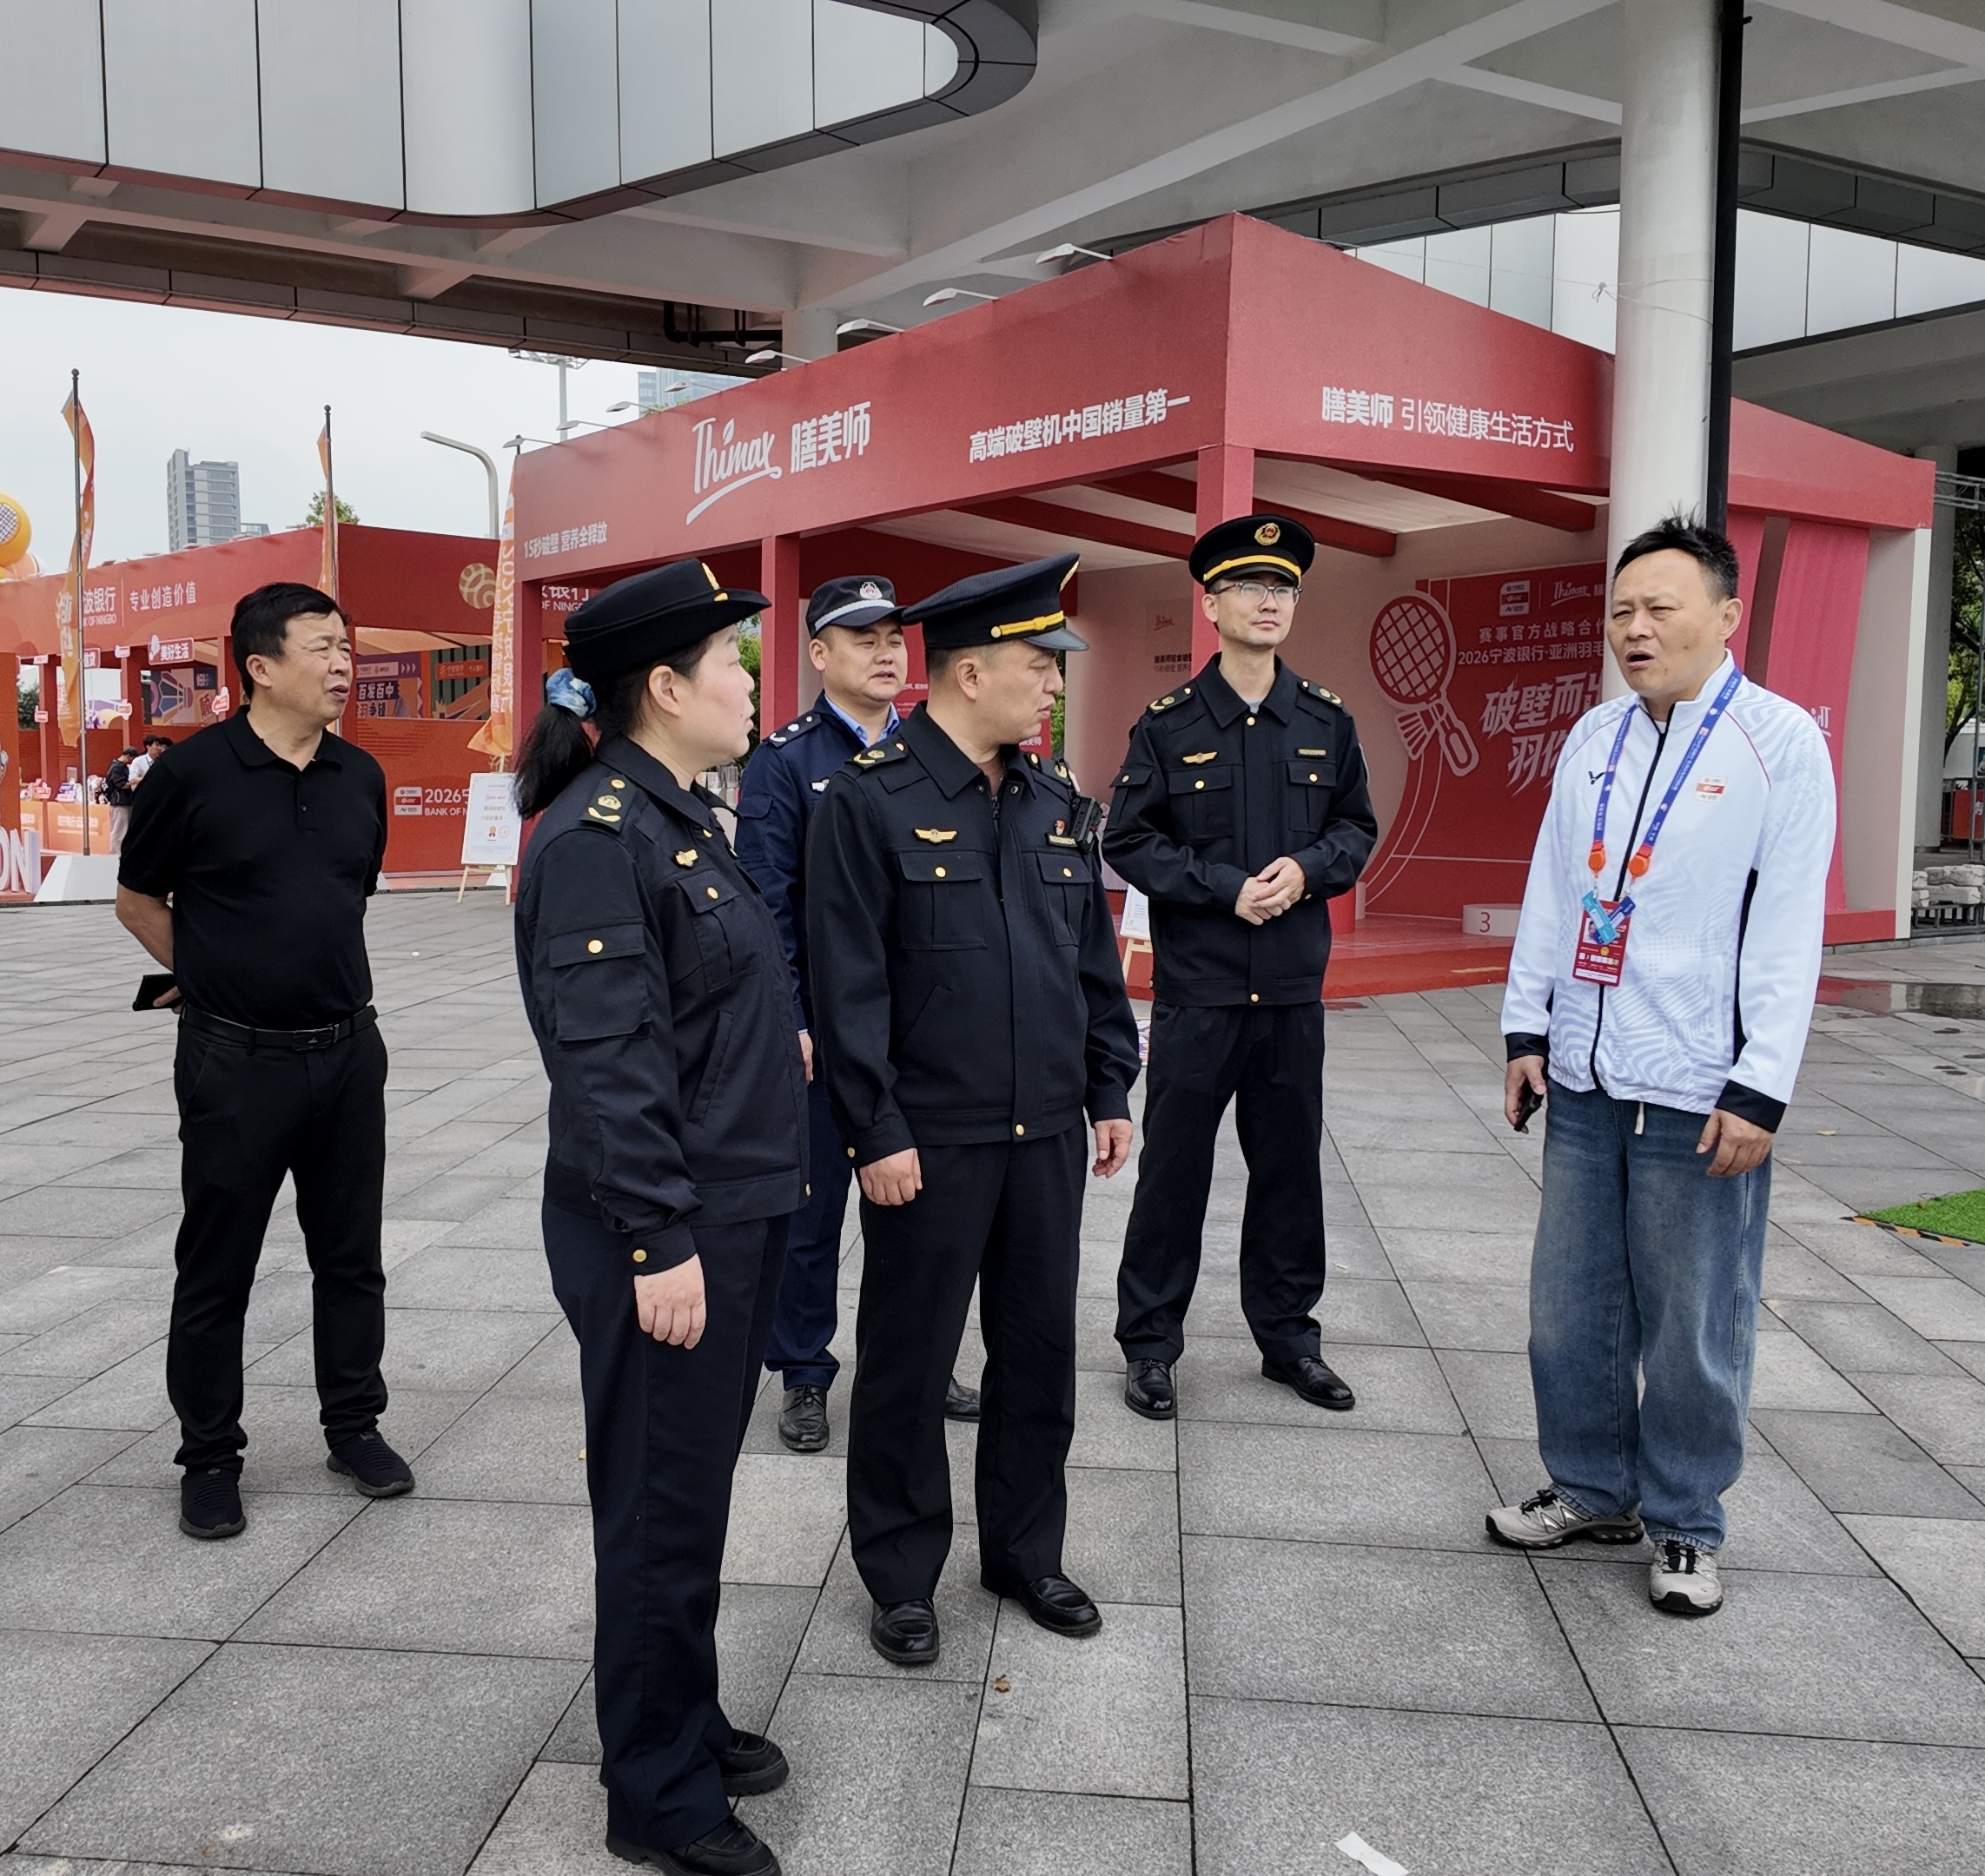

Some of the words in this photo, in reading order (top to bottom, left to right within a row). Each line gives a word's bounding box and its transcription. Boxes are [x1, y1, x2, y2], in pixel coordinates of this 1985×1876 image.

[969, 387, 1190, 463] 高端破壁机中国销量第一
[1321, 386, 1393, 428] 膳美师
[1400, 398, 1574, 452] 引领健康生活方式
[685, 418, 783, 525] Thimax
[790, 401, 871, 473] 膳美师
[523, 532, 559, 559] 15秒破壁
[561, 521, 608, 552] 营养全释放
[129, 580, 196, 612] 专业创造价值
[160, 643, 189, 661] 美好生活
[358, 682, 394, 700] 百发百中
[424, 807, 448, 816] BANK
[449, 807, 461, 816] OF
[1479, 911, 1491, 934] 3
